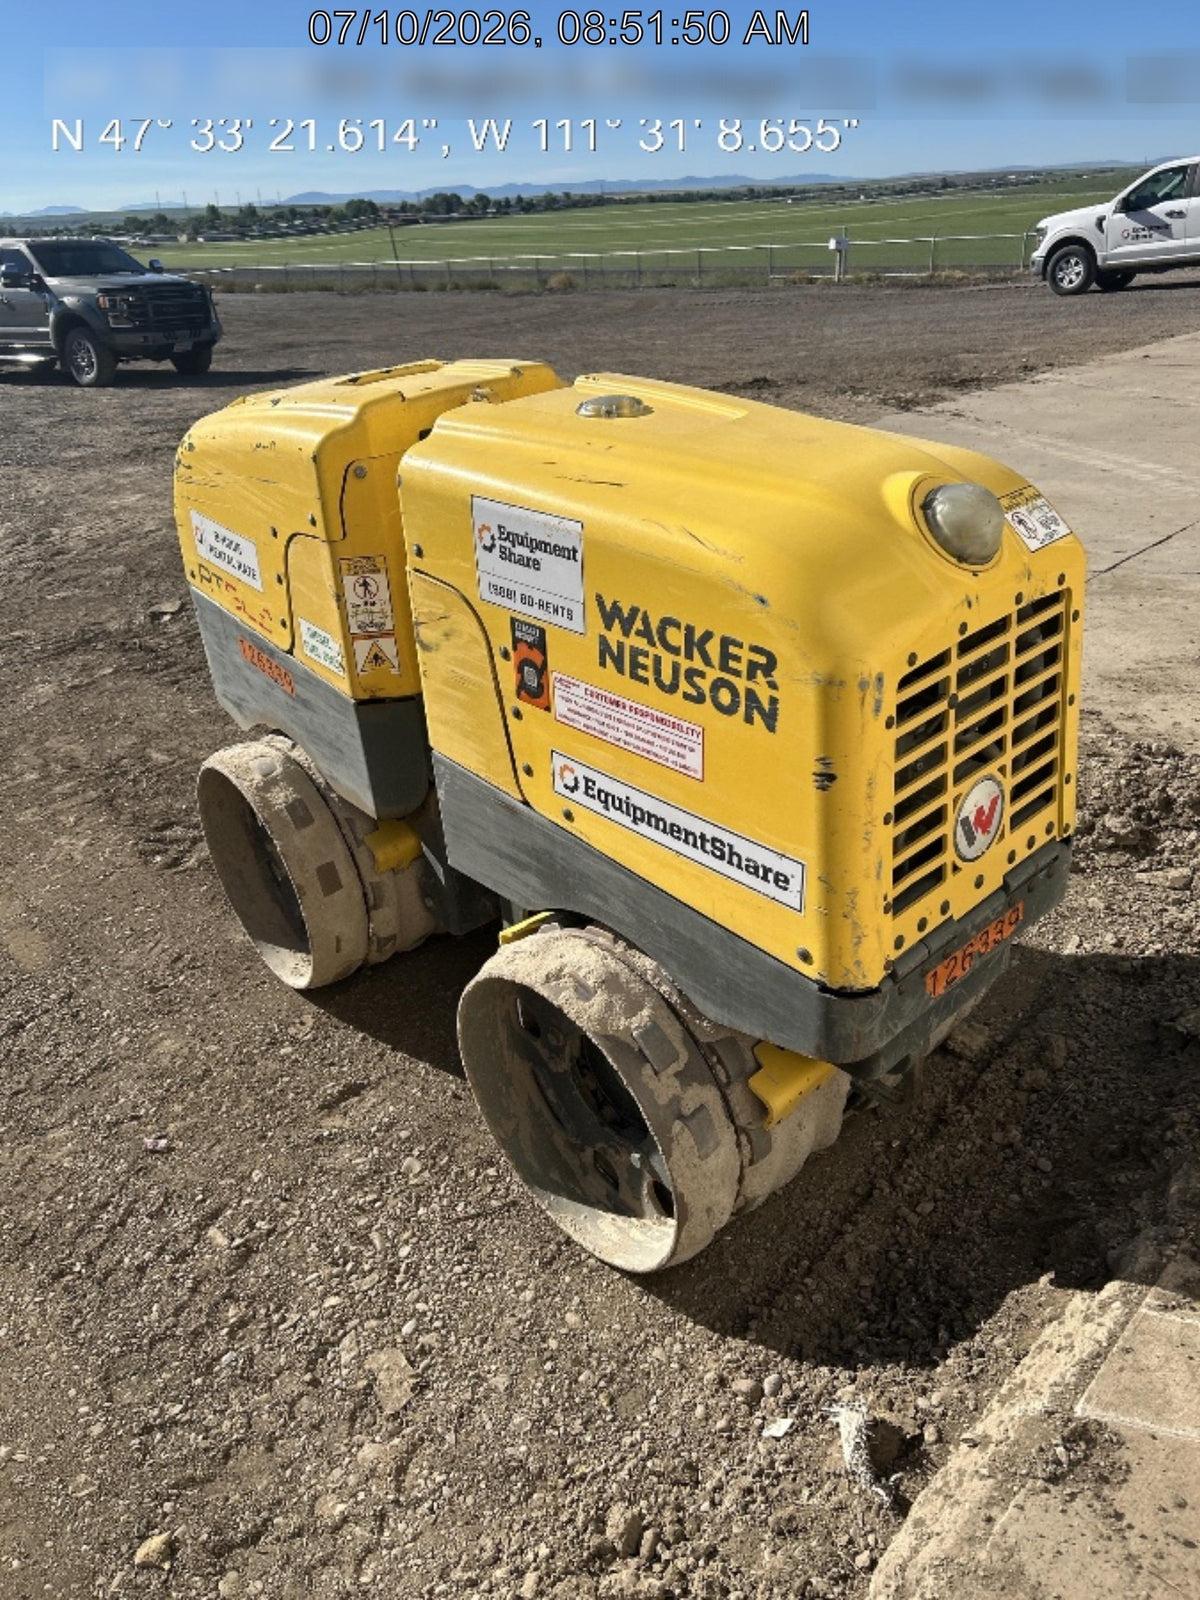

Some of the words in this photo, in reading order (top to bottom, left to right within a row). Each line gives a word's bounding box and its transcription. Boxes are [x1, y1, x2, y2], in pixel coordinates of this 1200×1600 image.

[497, 524, 579, 562] Equipment
[499, 544, 542, 572] Share
[595, 592, 779, 692] WACKER
[598, 633, 780, 734] NEUSON
[582, 775, 791, 892] EquipmentShare
[930, 906, 1020, 997] 126339
